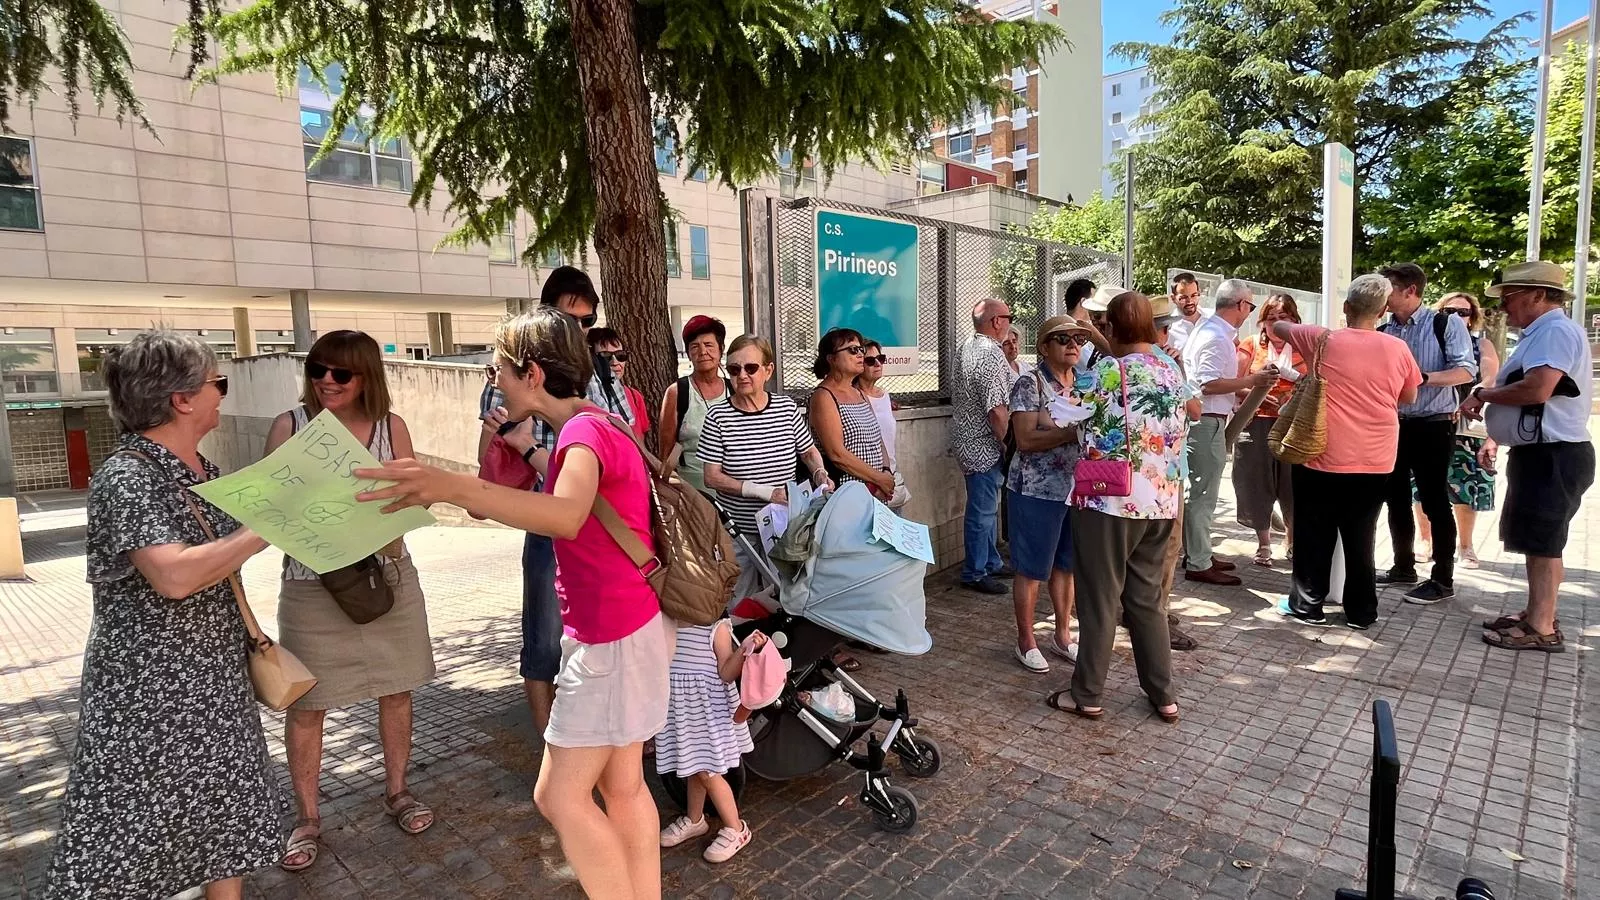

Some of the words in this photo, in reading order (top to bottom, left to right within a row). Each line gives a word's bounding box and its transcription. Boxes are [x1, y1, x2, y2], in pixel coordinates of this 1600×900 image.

[824, 222, 844, 236] C.S.
[824, 248, 898, 277] Pirineos
[883, 356, 911, 365] acionar
[270, 464, 305, 487] DE
